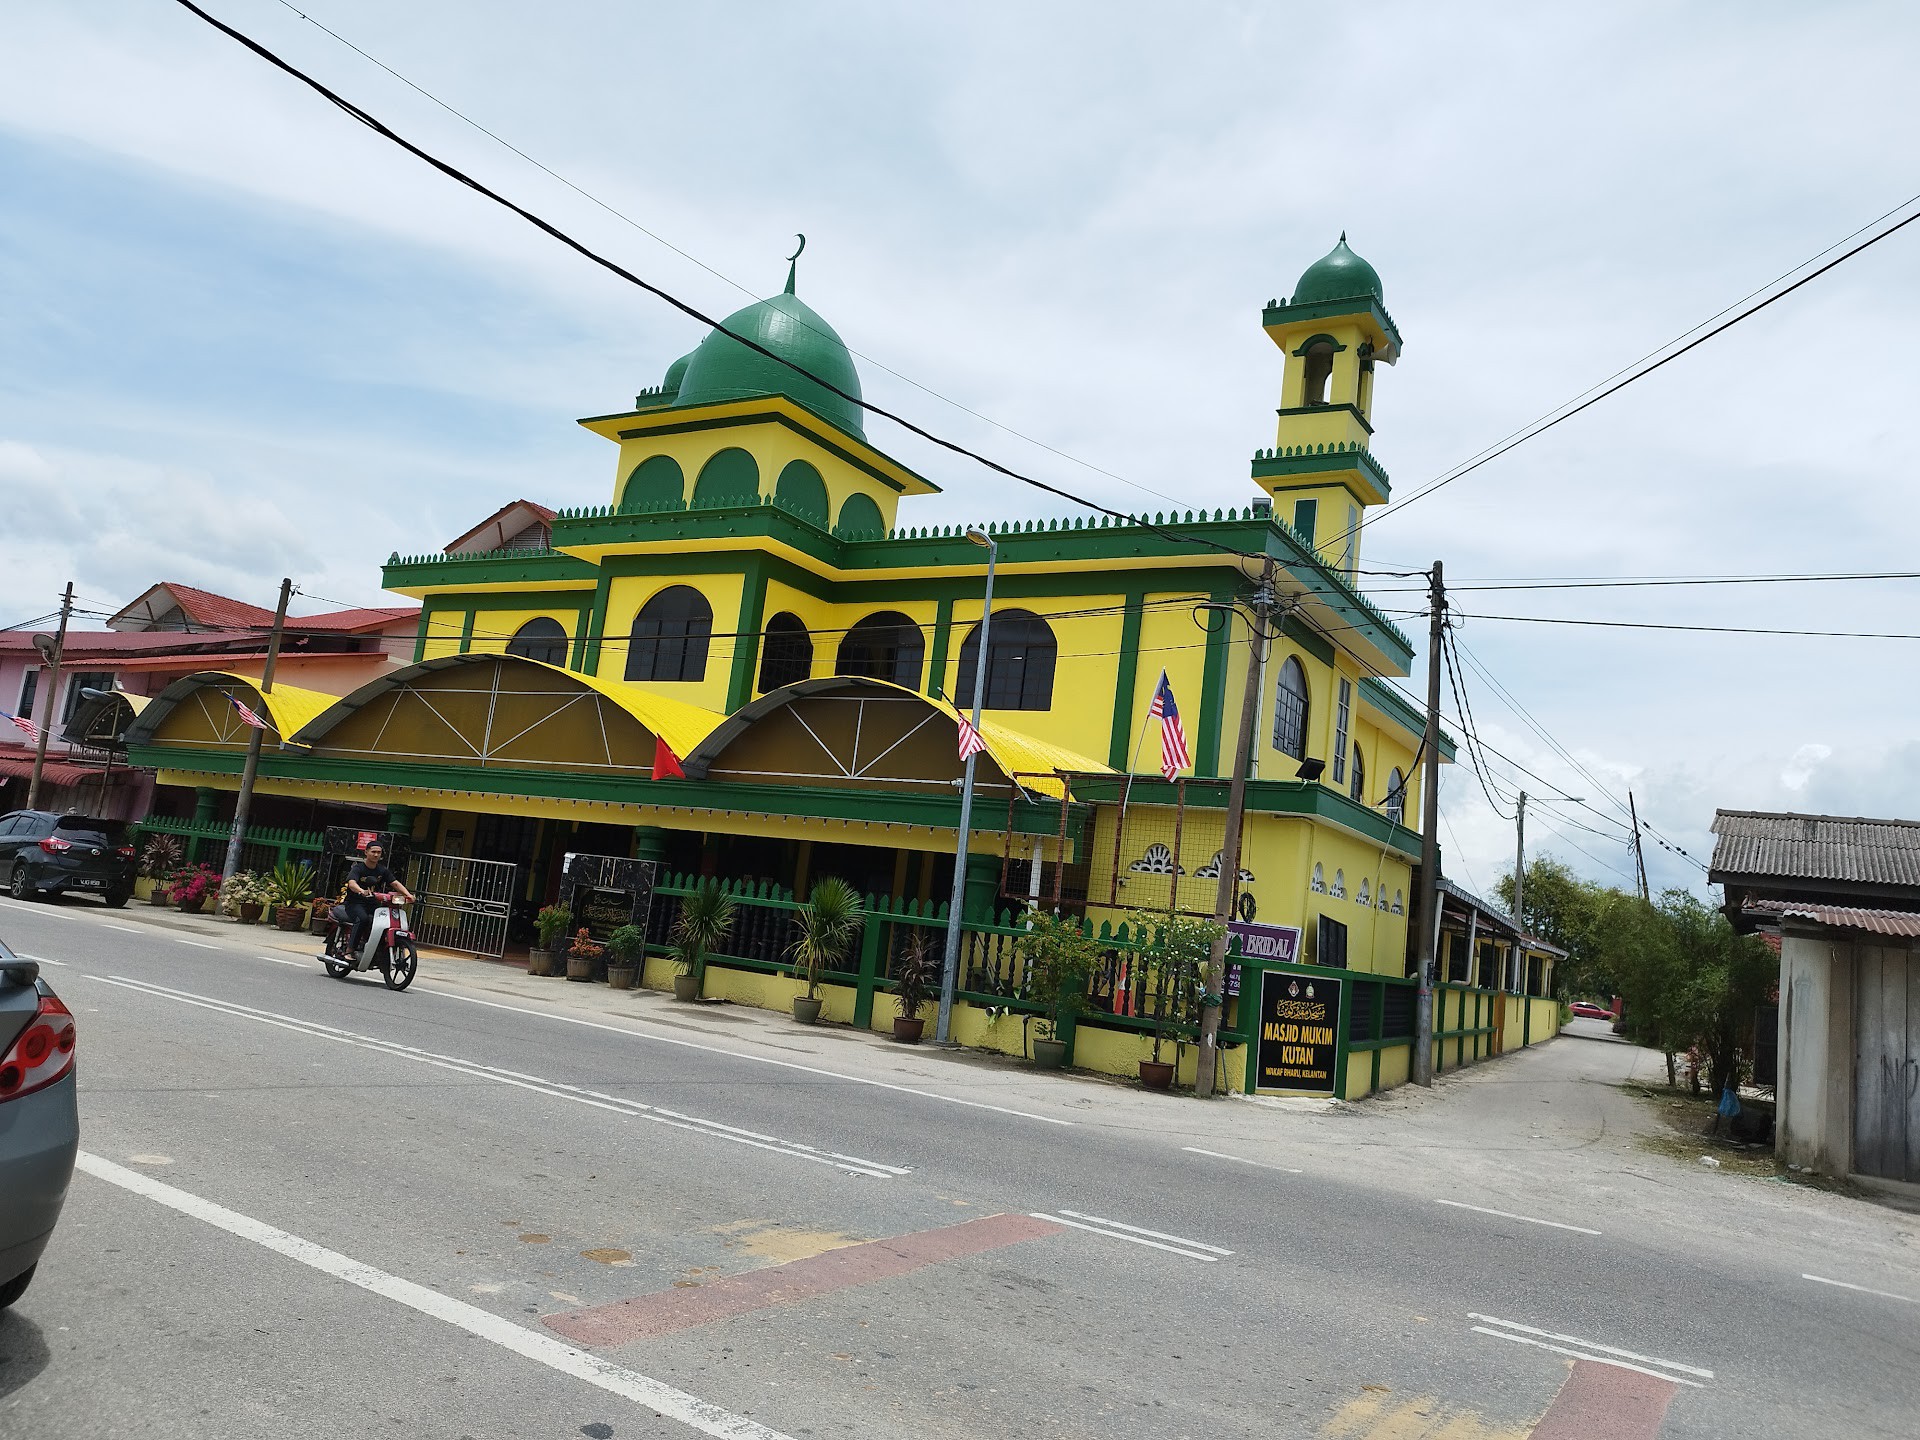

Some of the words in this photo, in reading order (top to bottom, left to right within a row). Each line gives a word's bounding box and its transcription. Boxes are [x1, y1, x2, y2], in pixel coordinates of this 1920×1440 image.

[1246, 935, 1291, 959] BRIDAL
[1264, 1022, 1299, 1043] MASJID
[1300, 1026, 1333, 1046] MUKIM
[1281, 1045, 1314, 1065] KUTAN
[1265, 1067, 1283, 1076] WAKAF
[1283, 1068, 1301, 1078] BHARU,
[1301, 1069, 1327, 1079] KELANTAN
